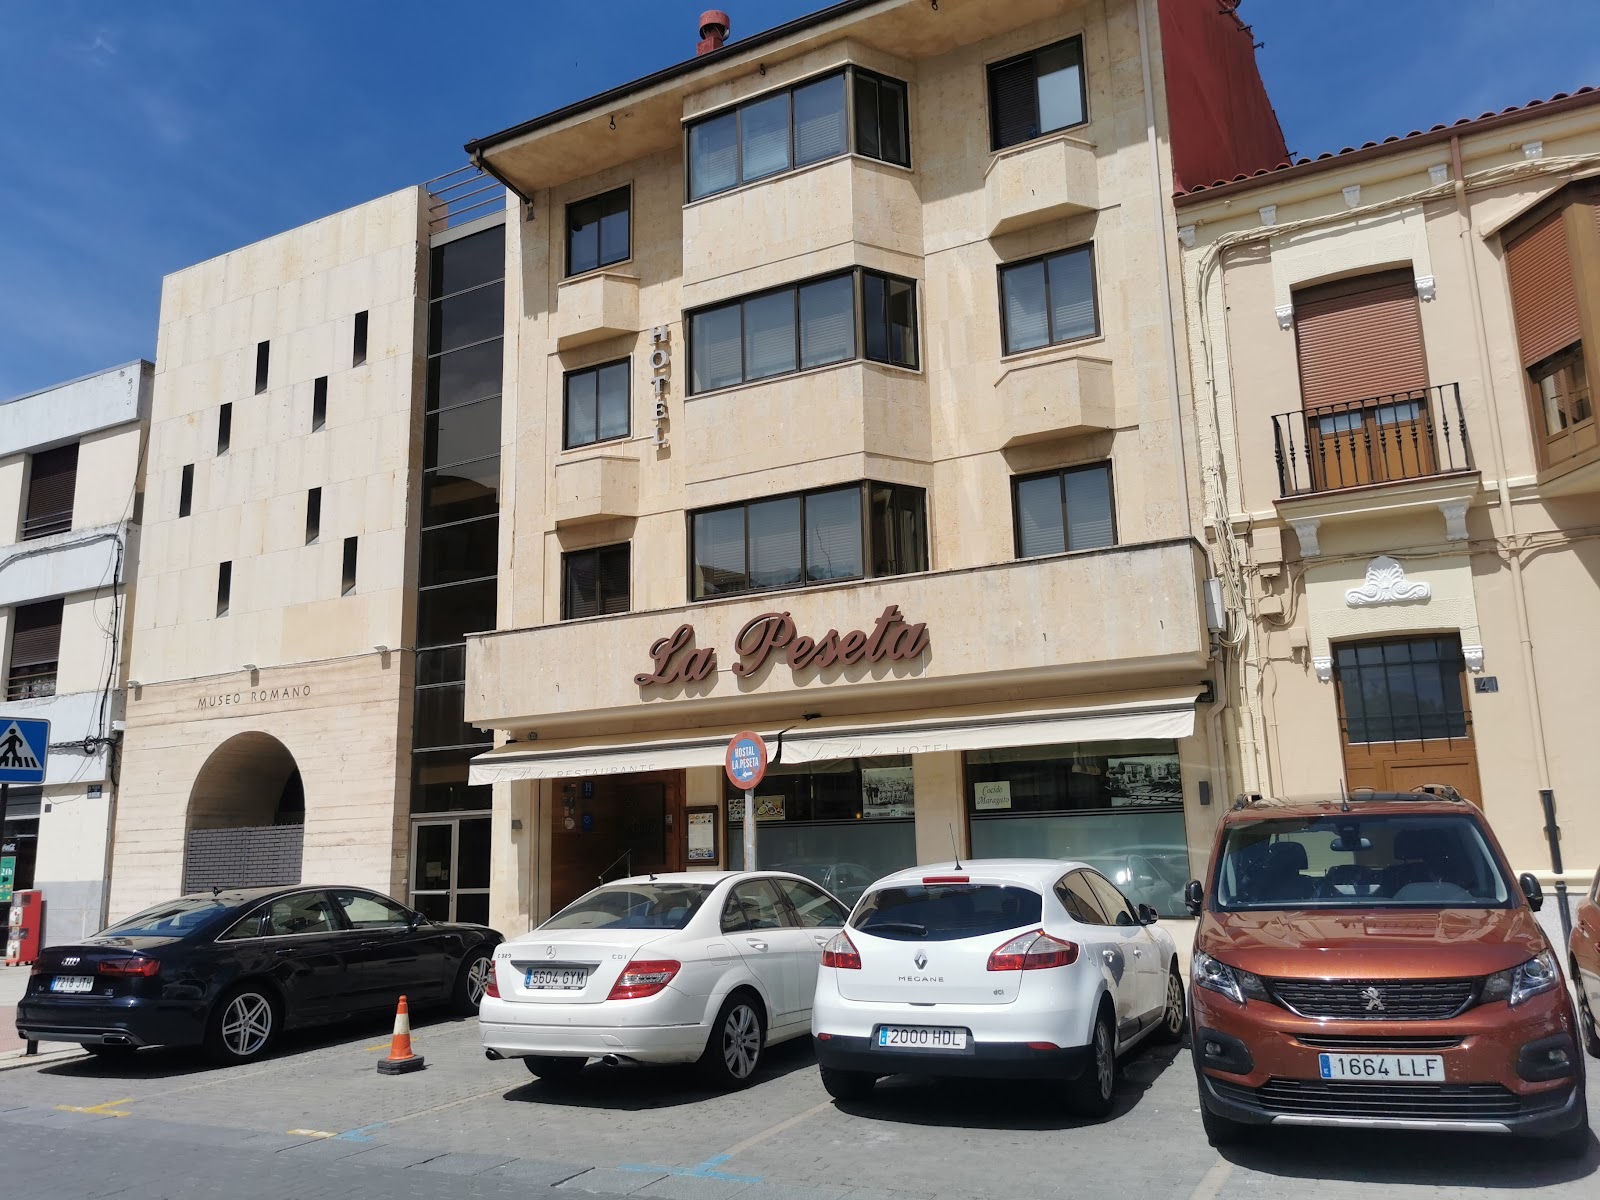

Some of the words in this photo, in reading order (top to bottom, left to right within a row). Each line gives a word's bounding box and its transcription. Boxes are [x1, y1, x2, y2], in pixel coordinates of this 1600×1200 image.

[649, 325, 668, 446] HOTEL
[634, 623, 717, 686] La
[732, 604, 930, 677] Peseta
[198, 693, 241, 709] MUSEO
[251, 685, 311, 702] ROMANO
[734, 746, 755, 758] HOSTAL
[731, 760, 739, 770] LA
[740, 757, 759, 768] PESETA
[982, 785, 1003, 796] Cocido
[976, 796, 1010, 806] Maragato
[56, 976, 75, 987] 7218
[76, 976, 92, 988] JTH
[532, 970, 558, 984] 5604
[562, 970, 585, 984] GYM
[890, 1028, 928, 1044] 2000
[932, 1029, 961, 1046] HDL
[1338, 1057, 1390, 1076] 1664
[1396, 1058, 1438, 1077] LLF
